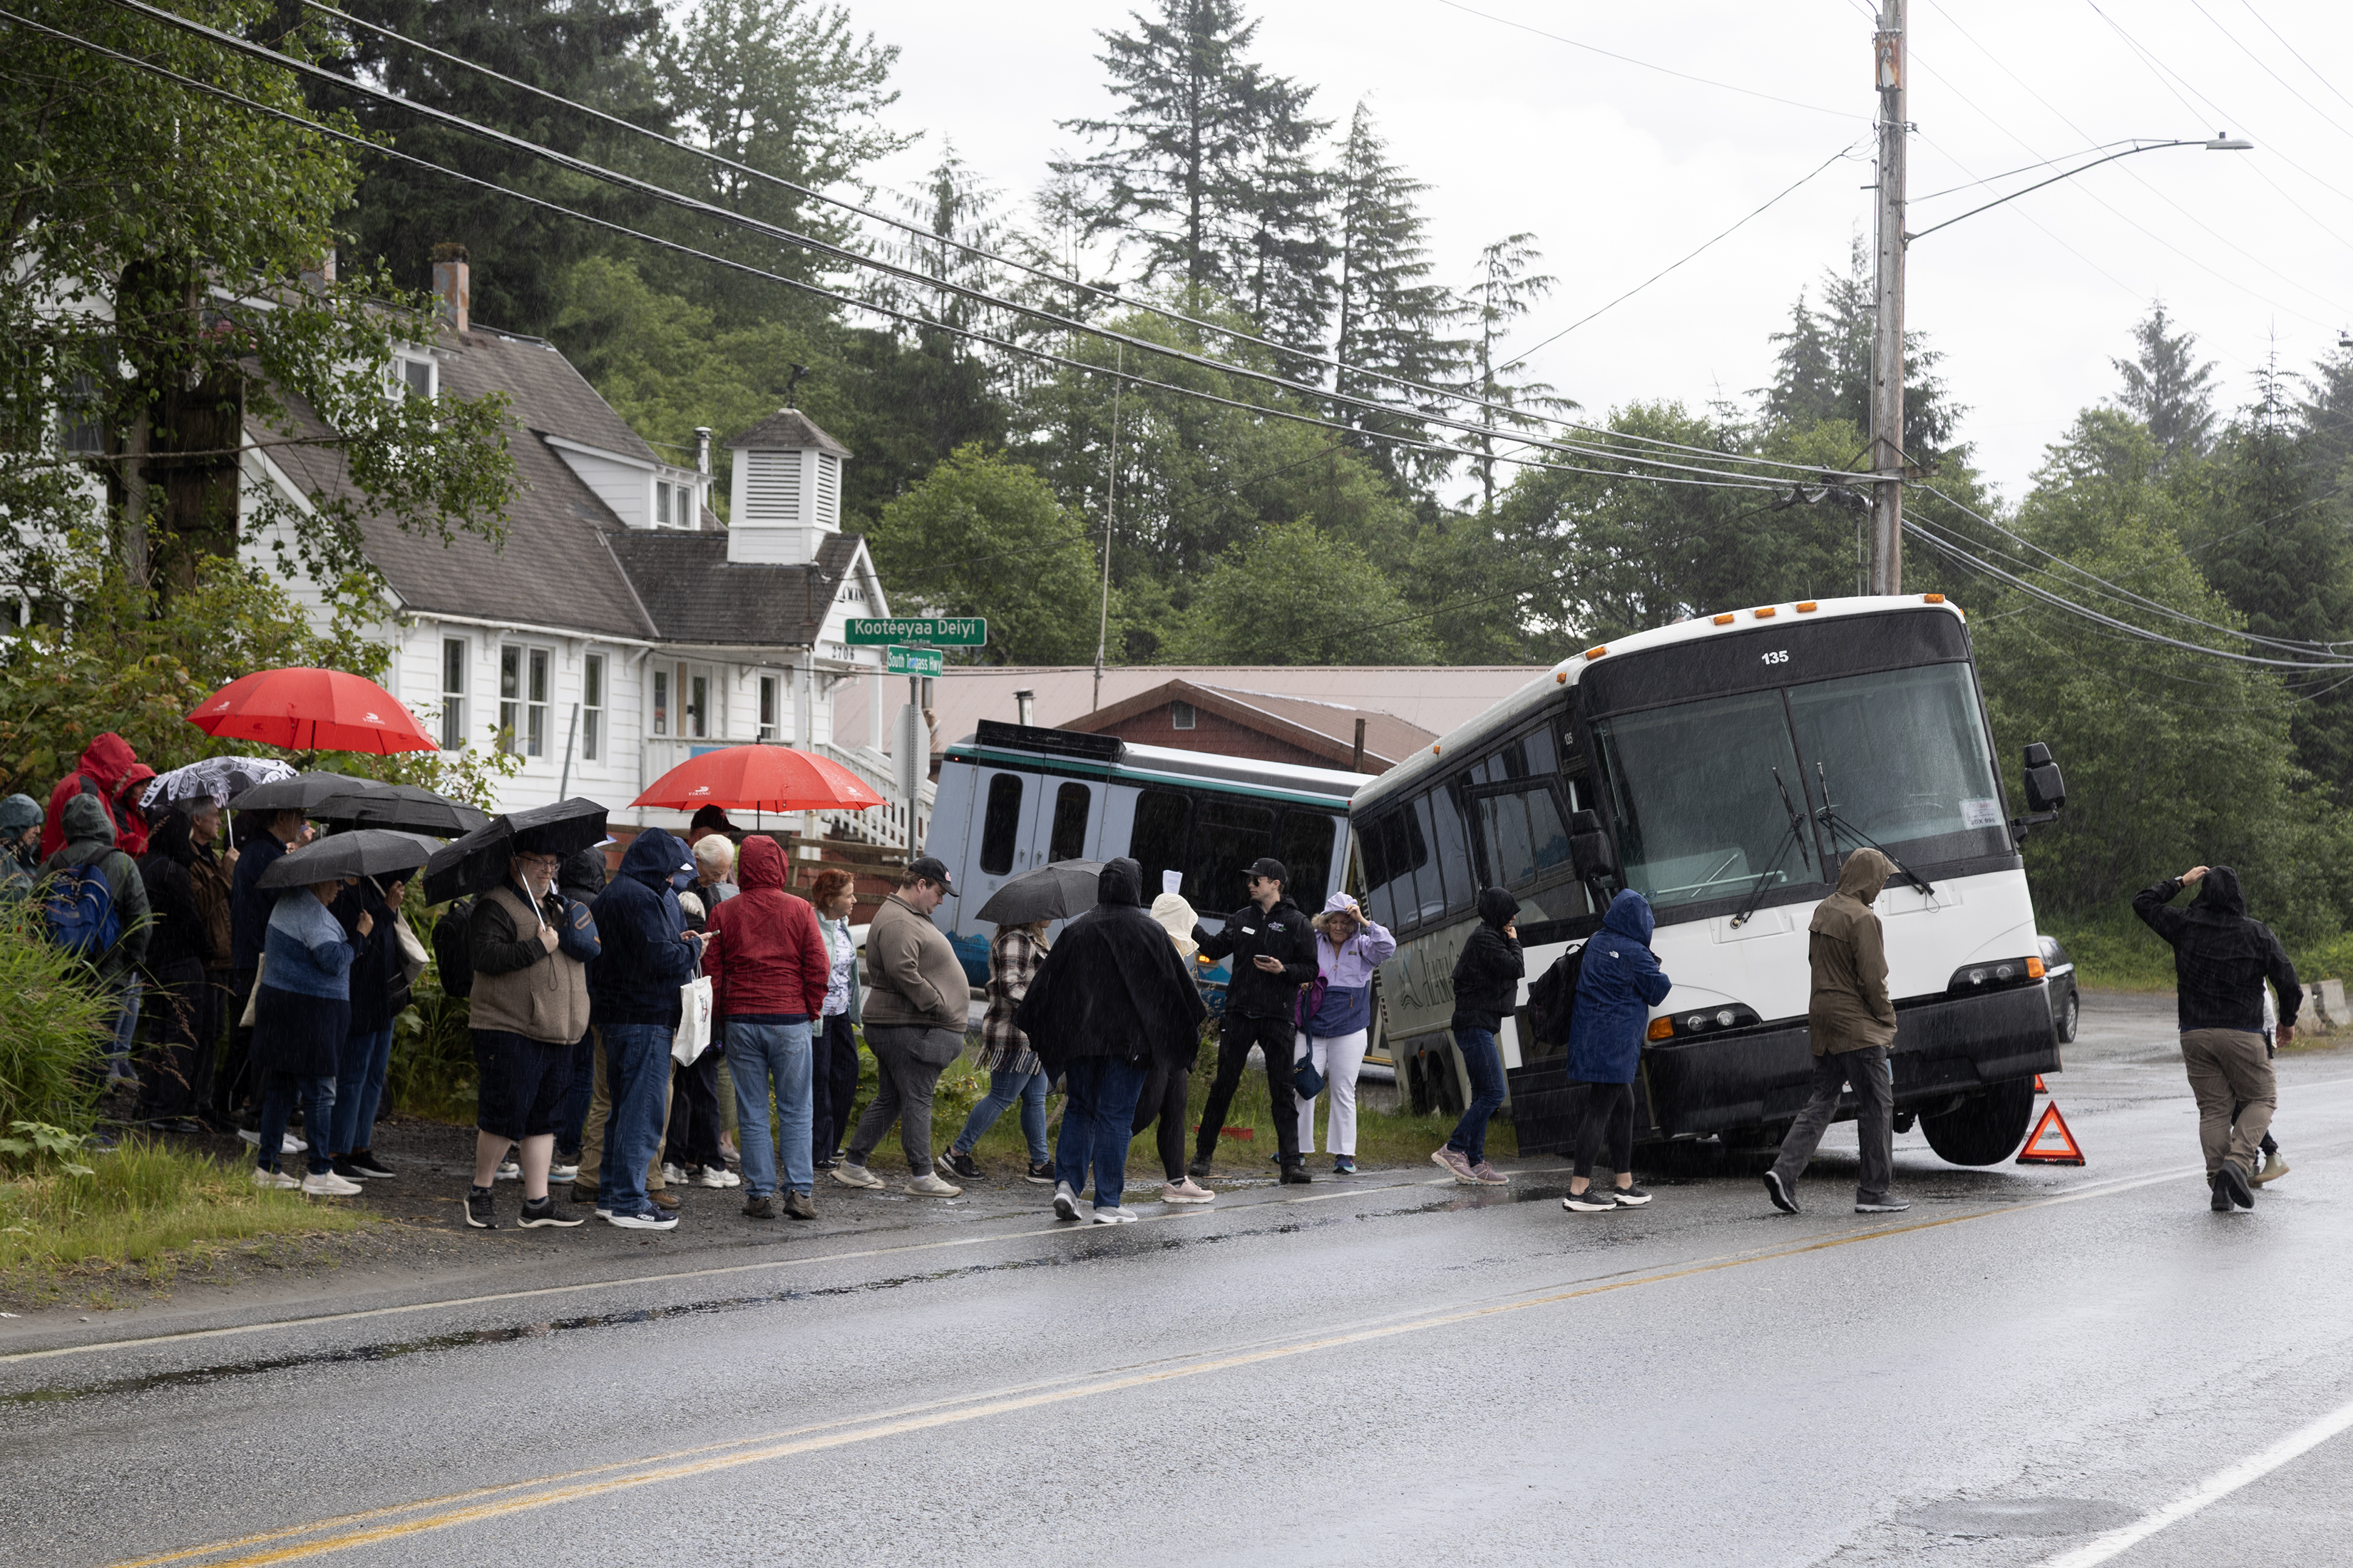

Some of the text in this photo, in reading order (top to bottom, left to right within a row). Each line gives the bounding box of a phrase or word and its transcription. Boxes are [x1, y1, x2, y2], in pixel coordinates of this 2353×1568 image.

[855, 619, 975, 638] Kootéeyaa Deiyí
[831, 645, 854, 660] 2706
[1761, 650, 1789, 665] 135
[888, 652, 905, 668] South
[929, 656, 942, 675] Hwy
[1564, 732, 1573, 745] 135
[944, 1152, 956, 1166] HOKA
